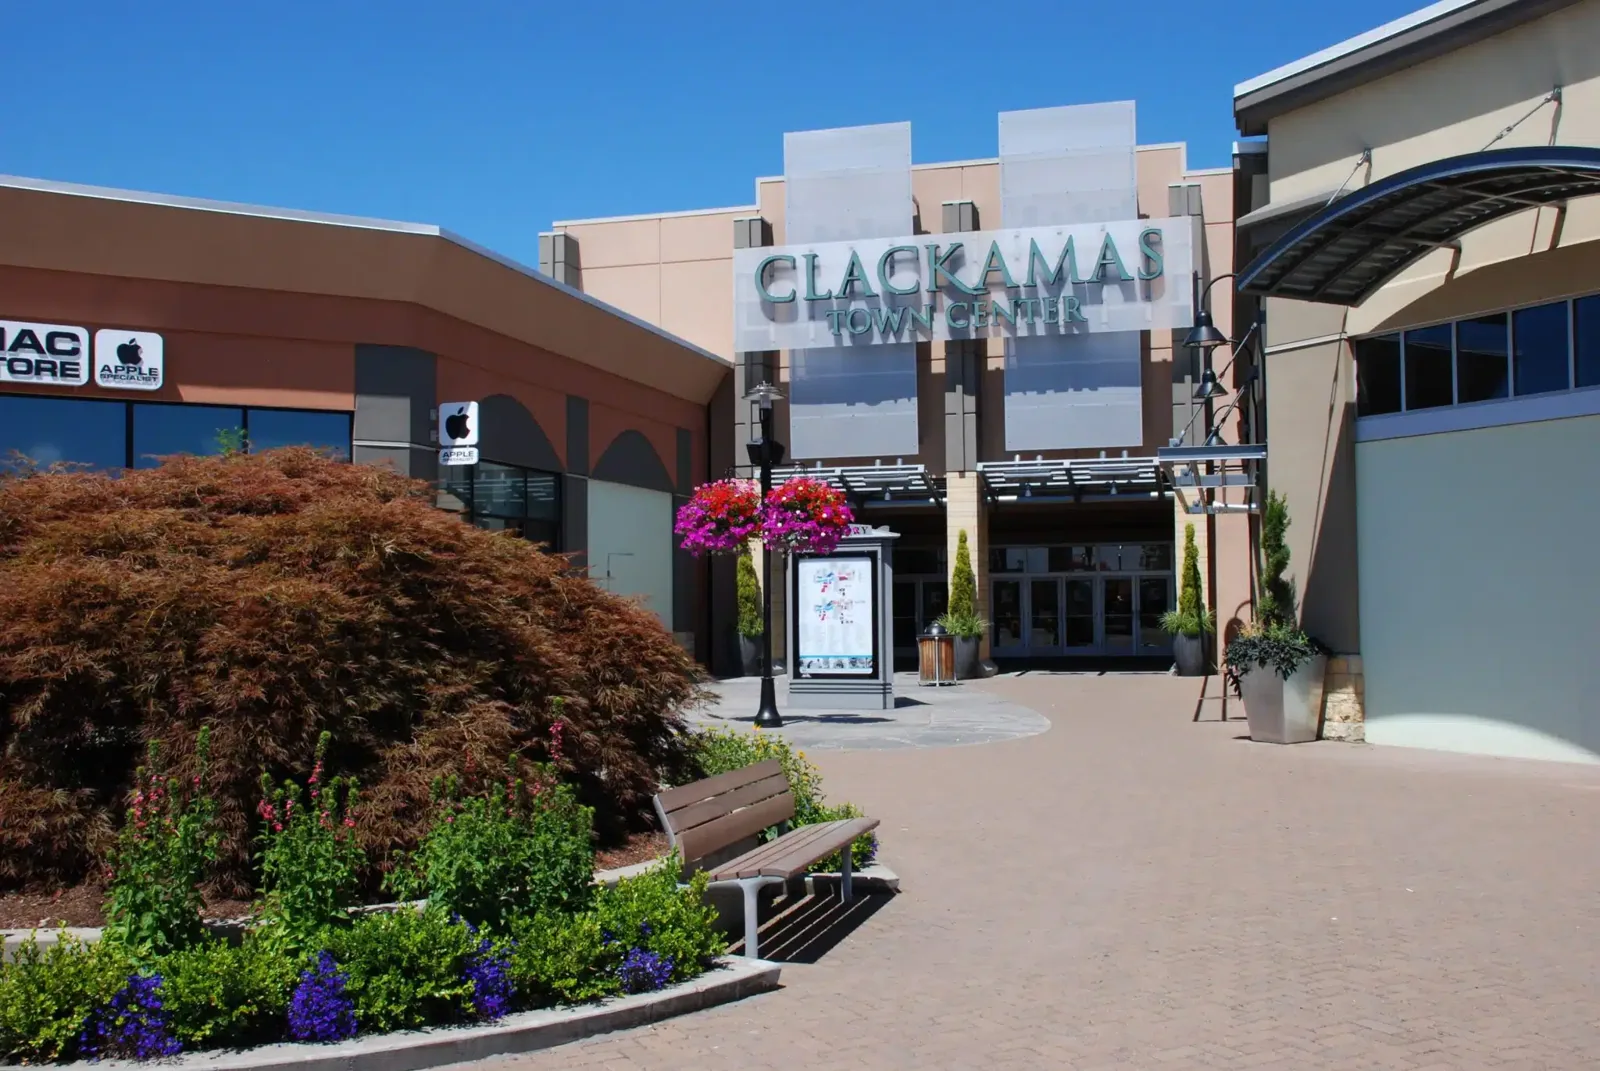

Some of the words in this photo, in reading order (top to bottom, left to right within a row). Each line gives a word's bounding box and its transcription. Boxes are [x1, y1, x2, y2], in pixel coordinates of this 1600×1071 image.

[754, 228, 1164, 304] CLACKAMAS
[826, 303, 933, 336] TOWN
[945, 295, 1088, 329] CENTER
[0, 327, 81, 357] AC
[0, 356, 81, 379] ORE
[100, 364, 159, 377] APPLE
[442, 450, 474, 458] APPLE
